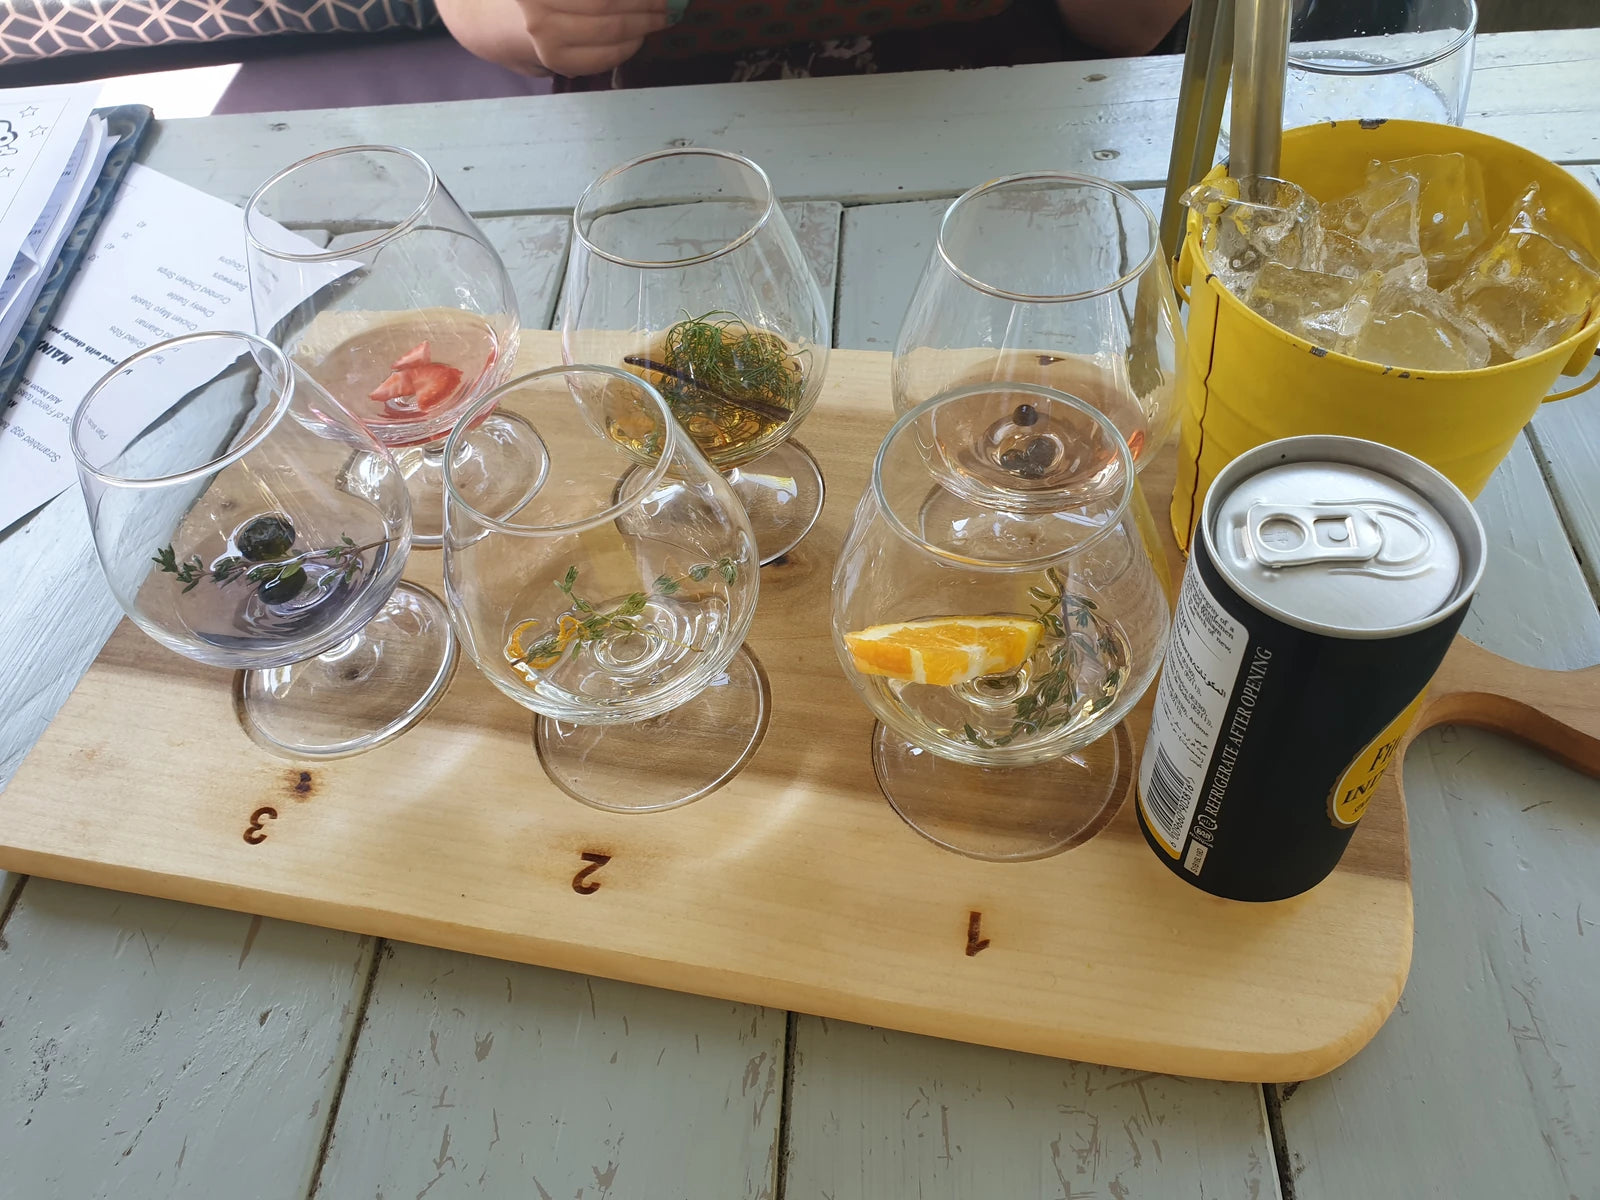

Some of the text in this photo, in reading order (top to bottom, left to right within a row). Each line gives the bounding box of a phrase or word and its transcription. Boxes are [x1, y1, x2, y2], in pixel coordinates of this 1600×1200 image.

[157, 267, 230, 304] Crumbed Chicken Strips
[167, 292, 189, 306] Toastie
[131, 295, 197, 332] Chicken Mayo Toastie
[59, 332, 85, 350] chunky
[110, 326, 125, 338] Ribs
[84, 347, 102, 358] with
[30, 384, 49, 398] bacon
[31, 399, 55, 415] French
[22, 436, 60, 462] Scrambled
[1205, 647, 1273, 817] REFRIGERATE AFTER OPENING
[242, 806, 278, 845] 3
[571, 852, 612, 896] 2
[966, 910, 990, 958] 1
